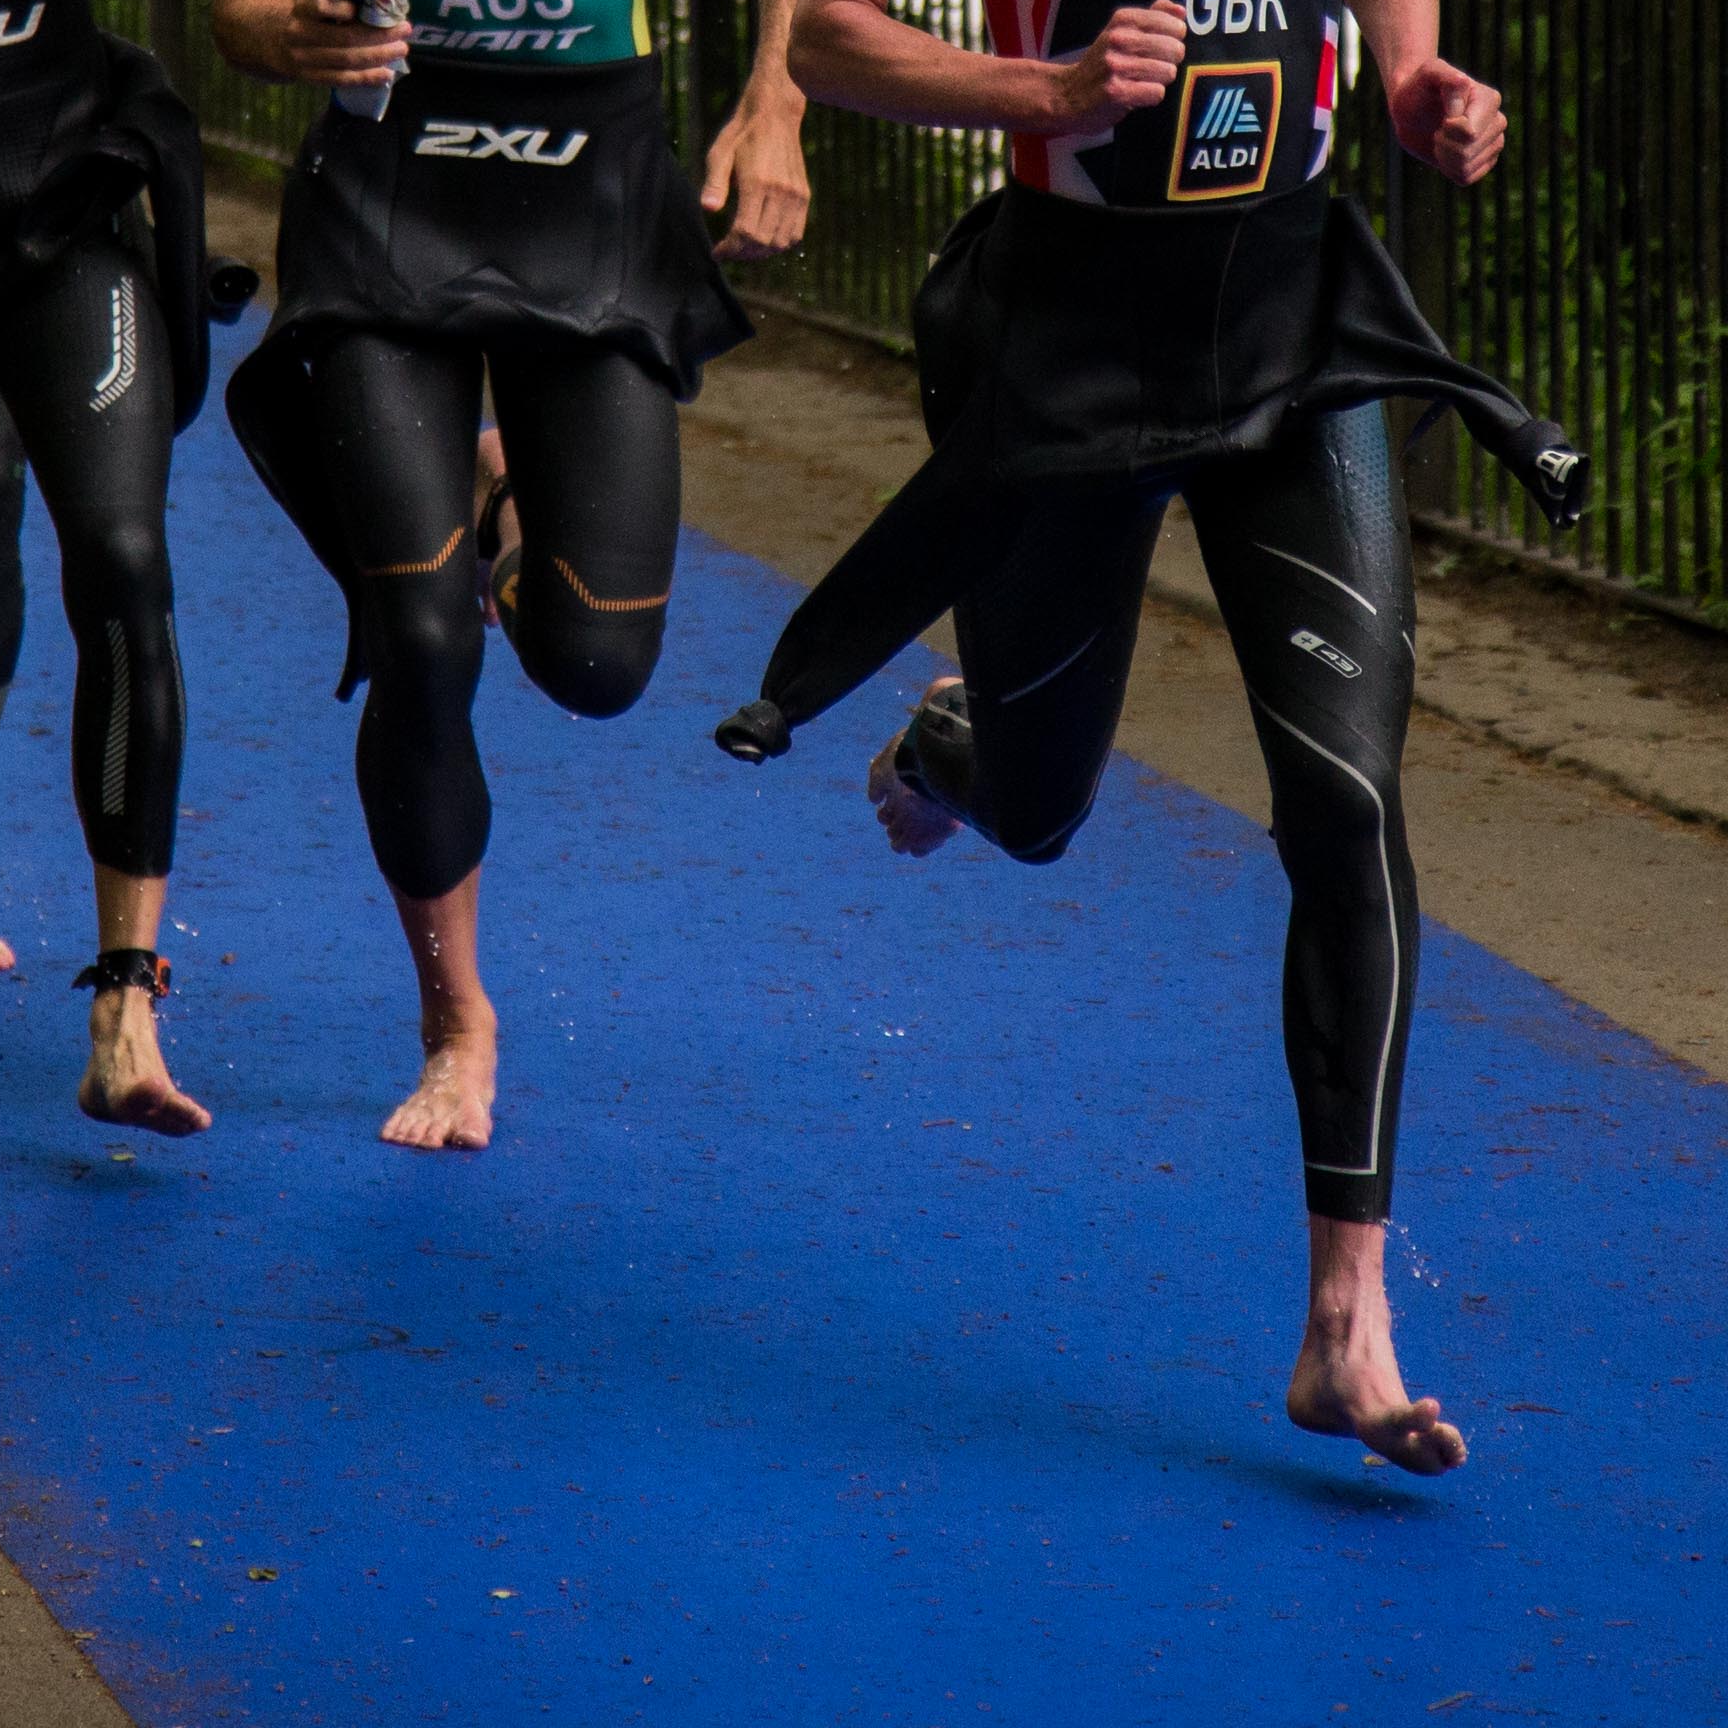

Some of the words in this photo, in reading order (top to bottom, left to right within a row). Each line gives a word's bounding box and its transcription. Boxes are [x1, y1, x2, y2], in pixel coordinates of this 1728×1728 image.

[408, 23, 596, 51] GIANT
[415, 121, 589, 167] 2XU
[1190, 146, 1259, 170] ALDI
